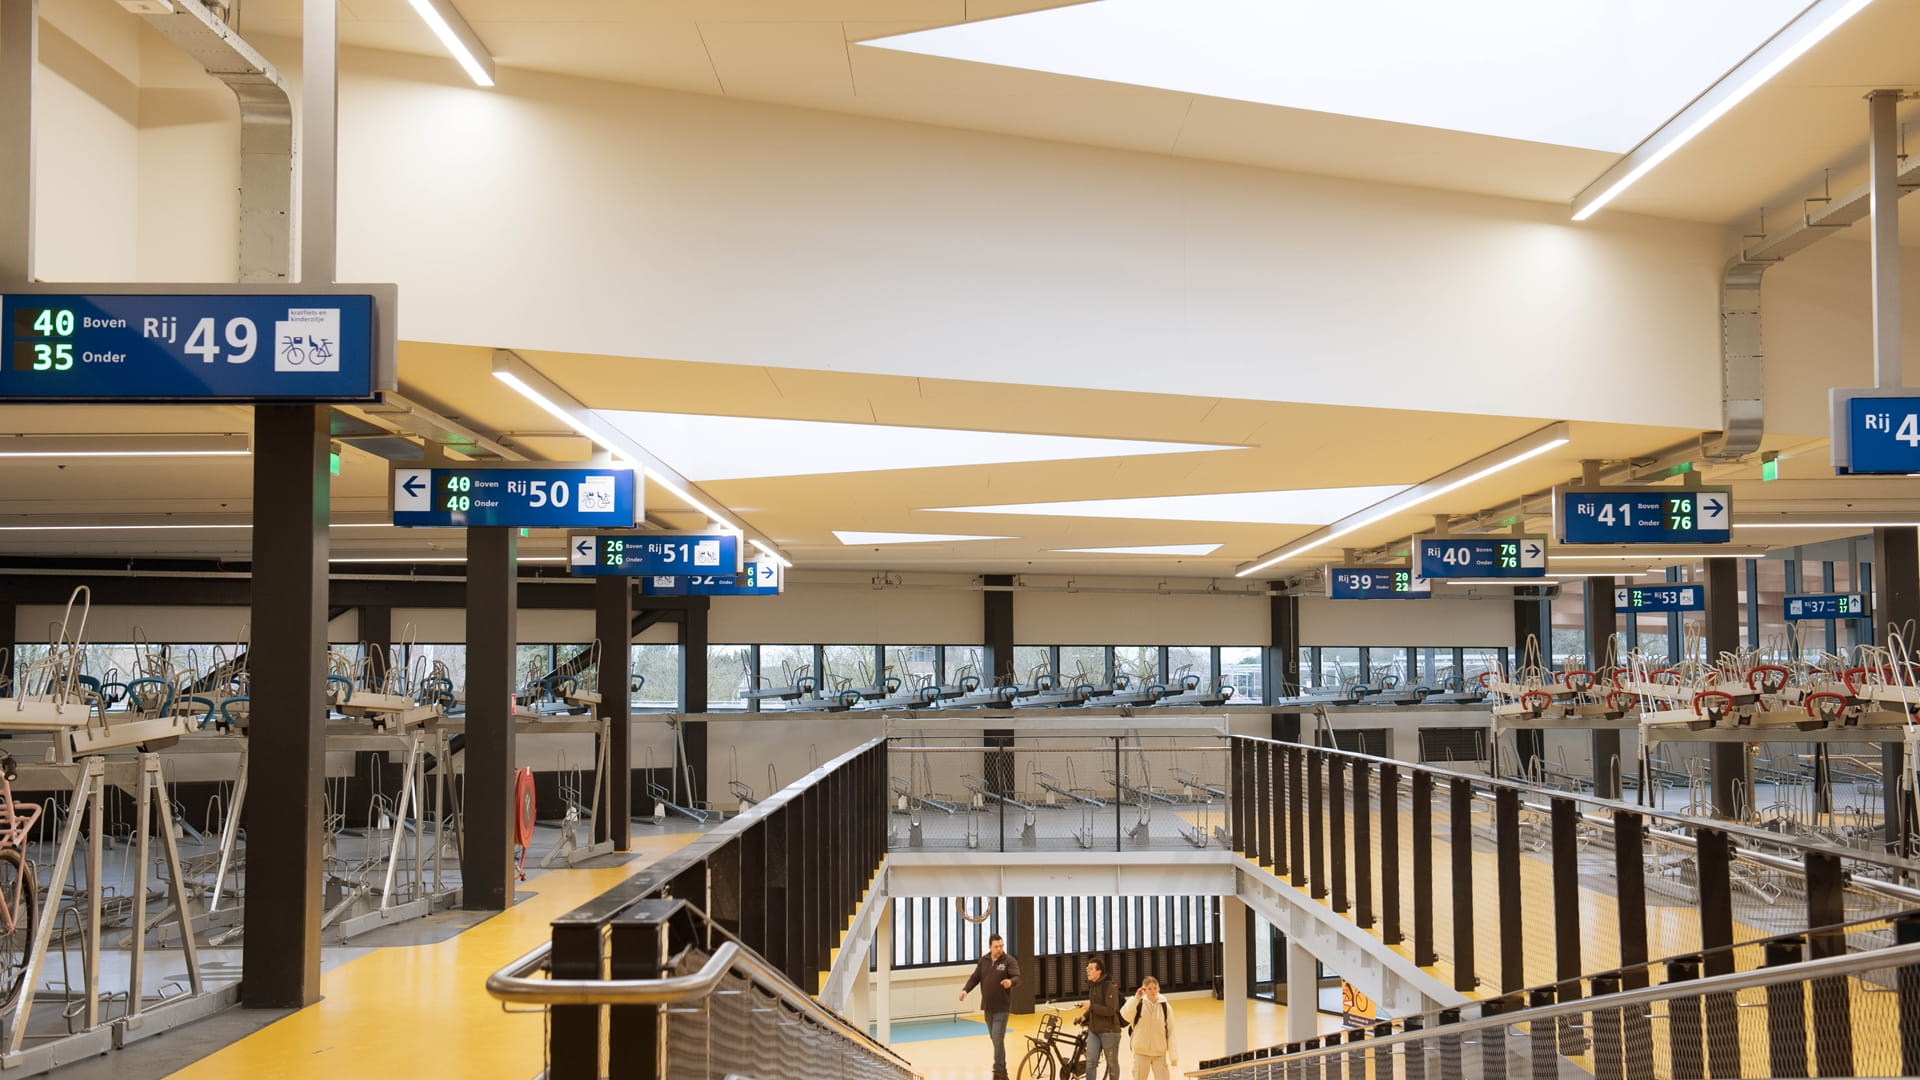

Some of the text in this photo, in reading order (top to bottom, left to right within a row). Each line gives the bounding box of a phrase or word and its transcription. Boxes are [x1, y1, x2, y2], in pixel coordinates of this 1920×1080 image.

[33, 309, 127, 337] 40 Boven
[143, 317, 258, 365] Rij 49
[33, 343, 126, 371] 35 Onder
[1865, 413, 1890, 433] Rij
[447, 476, 499, 492] 40 Boven
[507, 481, 569, 508] Rij 50
[447, 496, 470, 512] 40
[1670, 499, 1691, 513] 76
[1577, 503, 1631, 526] Rij 41
[1671, 516, 1692, 530] 76
[607, 540, 623, 552] 26
[648, 543, 689, 563] Rij 51
[1501, 544, 1517, 555] 76
[607, 554, 623, 565] 26
[1427, 547, 1471, 566] Rij 40
[1501, 557, 1517, 567] 76
[747, 567, 754, 576] 6
[747, 578, 754, 587] 6
[1338, 575, 1372, 590] Rij 39
[1396, 583, 1408, 591] 22
[1632, 590, 1642, 598] 72
[1662, 591, 1677, 604] 53
[1633, 599, 1643, 607] 72
[1811, 601, 1825, 612] 37
